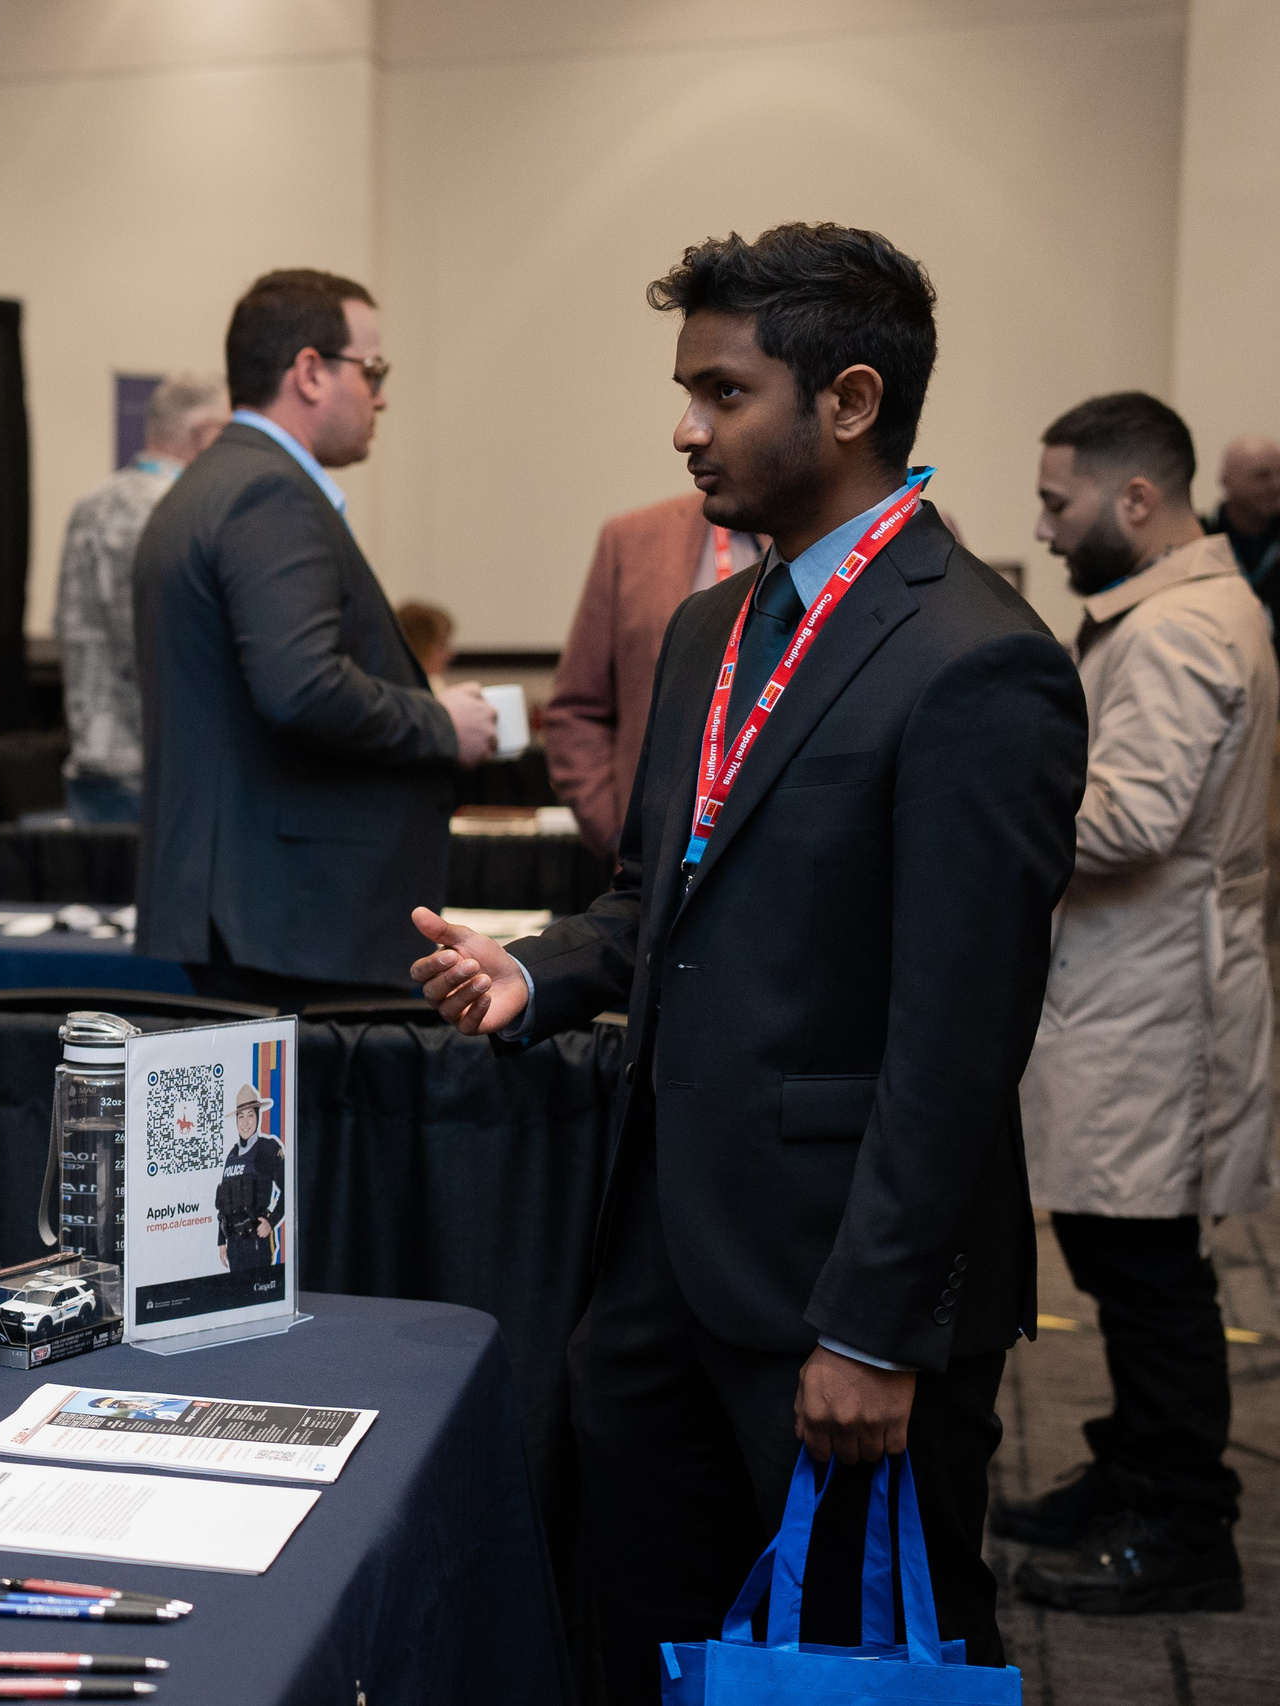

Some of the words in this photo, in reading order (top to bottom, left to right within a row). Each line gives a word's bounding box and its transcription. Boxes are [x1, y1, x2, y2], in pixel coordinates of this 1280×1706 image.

[870, 511, 903, 540] Insignia
[844, 553, 858, 569] TAG
[807, 593, 833, 627] Custom
[783, 627, 813, 668] Branding
[765, 683, 776, 698] TAG
[709, 705, 722, 742] Insignia
[735, 724, 758, 760] Apparel
[705, 744, 718, 781] Uniform
[722, 761, 741, 785] Trims
[705, 801, 717, 815] TAG
[100, 1097, 122, 1106] 32oz
[224, 1164, 246, 1178] POLICE
[146, 1205, 176, 1220] Apply
[177, 1203, 200, 1214] Now
[146, 1216, 213, 1232] rcmp.ca/careers
